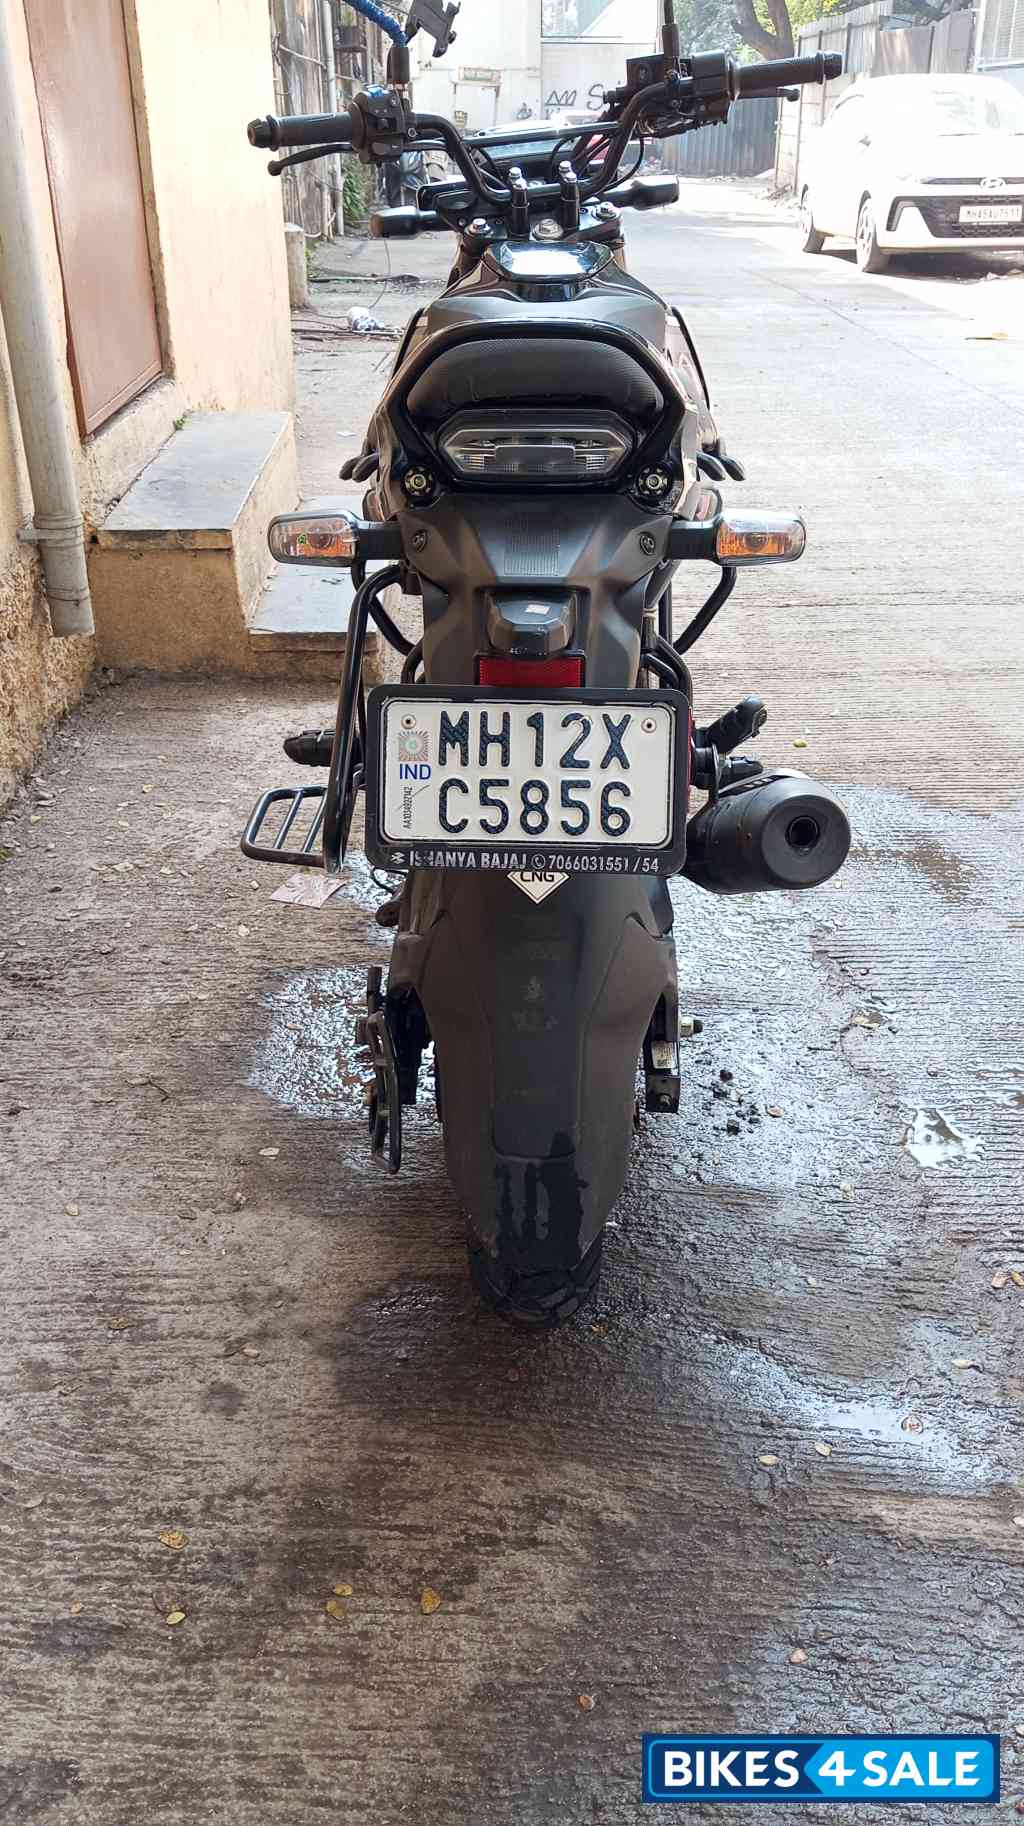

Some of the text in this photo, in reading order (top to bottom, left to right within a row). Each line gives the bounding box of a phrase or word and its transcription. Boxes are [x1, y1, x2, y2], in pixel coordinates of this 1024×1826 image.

[438, 710, 632, 770] MH12X
[399, 764, 432, 780] IND
[438, 777, 632, 837] C5856
[480, 852, 527, 870] BAJAJ
[520, 871, 555, 883] CNG
